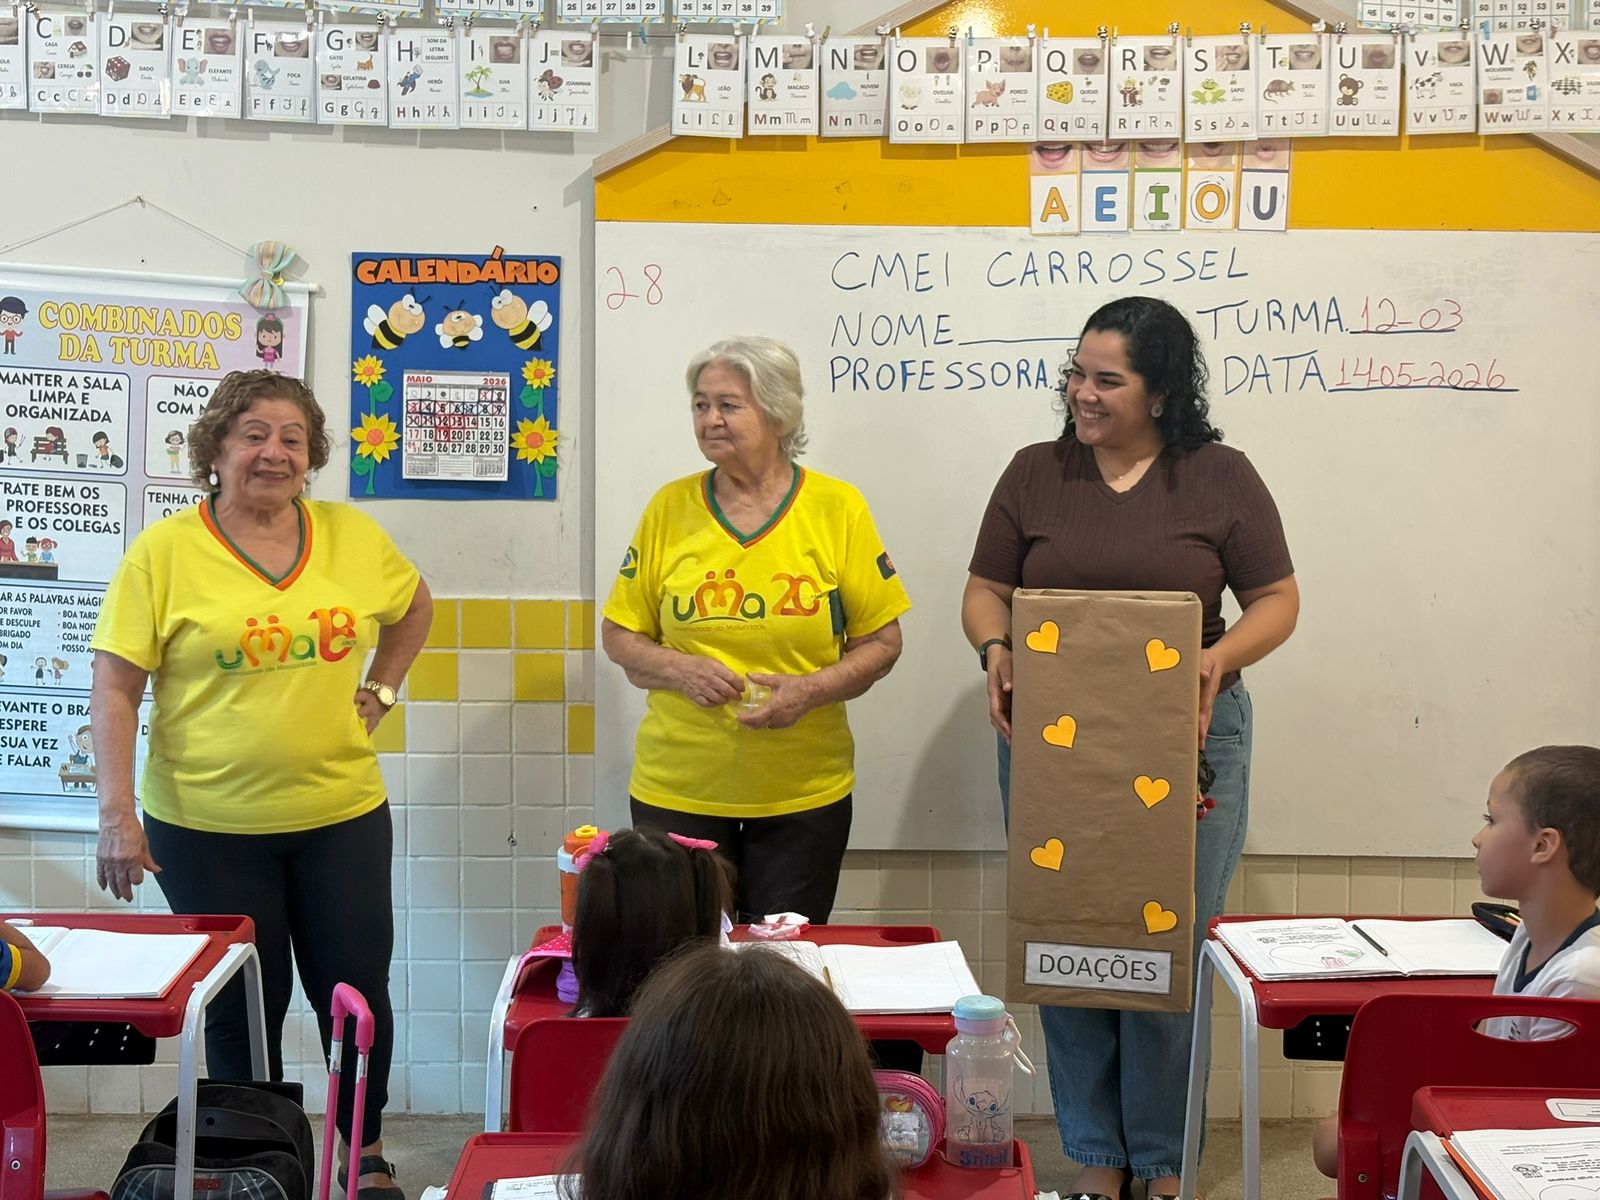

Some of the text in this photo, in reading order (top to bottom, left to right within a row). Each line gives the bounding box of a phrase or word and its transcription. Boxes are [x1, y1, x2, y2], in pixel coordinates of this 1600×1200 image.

[702, 3, 712, 11] 36
[761, 4, 772, 12] 39
[36, 17, 52, 39] C
[108, 25, 126, 48] D
[183, 29, 195, 50] E
[254, 33, 266, 54] F
[326, 30, 344, 51] G
[397, 40, 413, 62] H
[470, 40, 475, 62] I
[540, 42, 549, 64] J
[688, 46, 699, 68] L
[755, 47, 778, 69] M
[831, 49, 848, 70] N
[896, 49, 917, 73] O
[978, 50, 992, 73] P
[1122, 49, 1137, 71] R
[1194, 49, 1208, 72] S
[1266, 47, 1282, 69] T
[1339, 47, 1356, 69] U
[1415, 50, 1428, 67] V
[1481, 43, 1509, 65] W
[1554, 42, 1571, 64] X
[1046, 49, 1068, 75] Q
[1080, 88, 1098, 96] QUEIJO
[1039, 183, 1278, 222] A E I O U
[356, 245, 560, 286] CALENDÁRIO
[831, 247, 1249, 293] CMEI CARROSSEL
[605, 263, 664, 310] 28
[38, 301, 243, 342] COMBINADOS
[1360, 296, 1464, 334] 12-03
[58, 332, 221, 370] DA TURMA
[0, 371, 123, 392] MANTER A SALA
[406, 375, 507, 385] MAIO 2026
[1223, 349, 1327, 396] DATA
[30, 389, 90, 405] LIMPA E
[174, 381, 209, 398] NÃO
[6, 404, 112, 423] ORGANIZADA
[156, 401, 194, 416] COM
[480, 417, 491, 427] 15
[494, 418, 504, 427] 16
[408, 429, 504, 441] 17 18 19 20 21 22 23
[422, 442, 504, 454] 25 26 27 28 29 30
[44, 484, 76, 499] BEM
[80, 486, 100, 500] OS
[147, 491, 189, 505] TENHA
[6, 499, 109, 518] PROFESSORES
[15, 516, 121, 535] E OS COLEGAS
[15, 592, 26, 603] AS
[29, 592, 75, 606] PALAVRAS
[770, 571, 822, 617] 20
[10, 607, 33, 616] FAVOR
[62, 610, 100, 620] BOA TARD
[6, 618, 41, 628] DESCULPE
[62, 621, 77, 630] BOA
[10, 641, 23, 650] DIA
[62, 632, 79, 641] COM
[61, 644, 85, 653] POSSO
[52, 702, 63, 715] O
[0, 718, 48, 732] ESPERE
[0, 735, 59, 750] SUA VEZ
[7, 754, 52, 768] FALAR
[1039, 953, 1158, 983] DOAÇÕES
